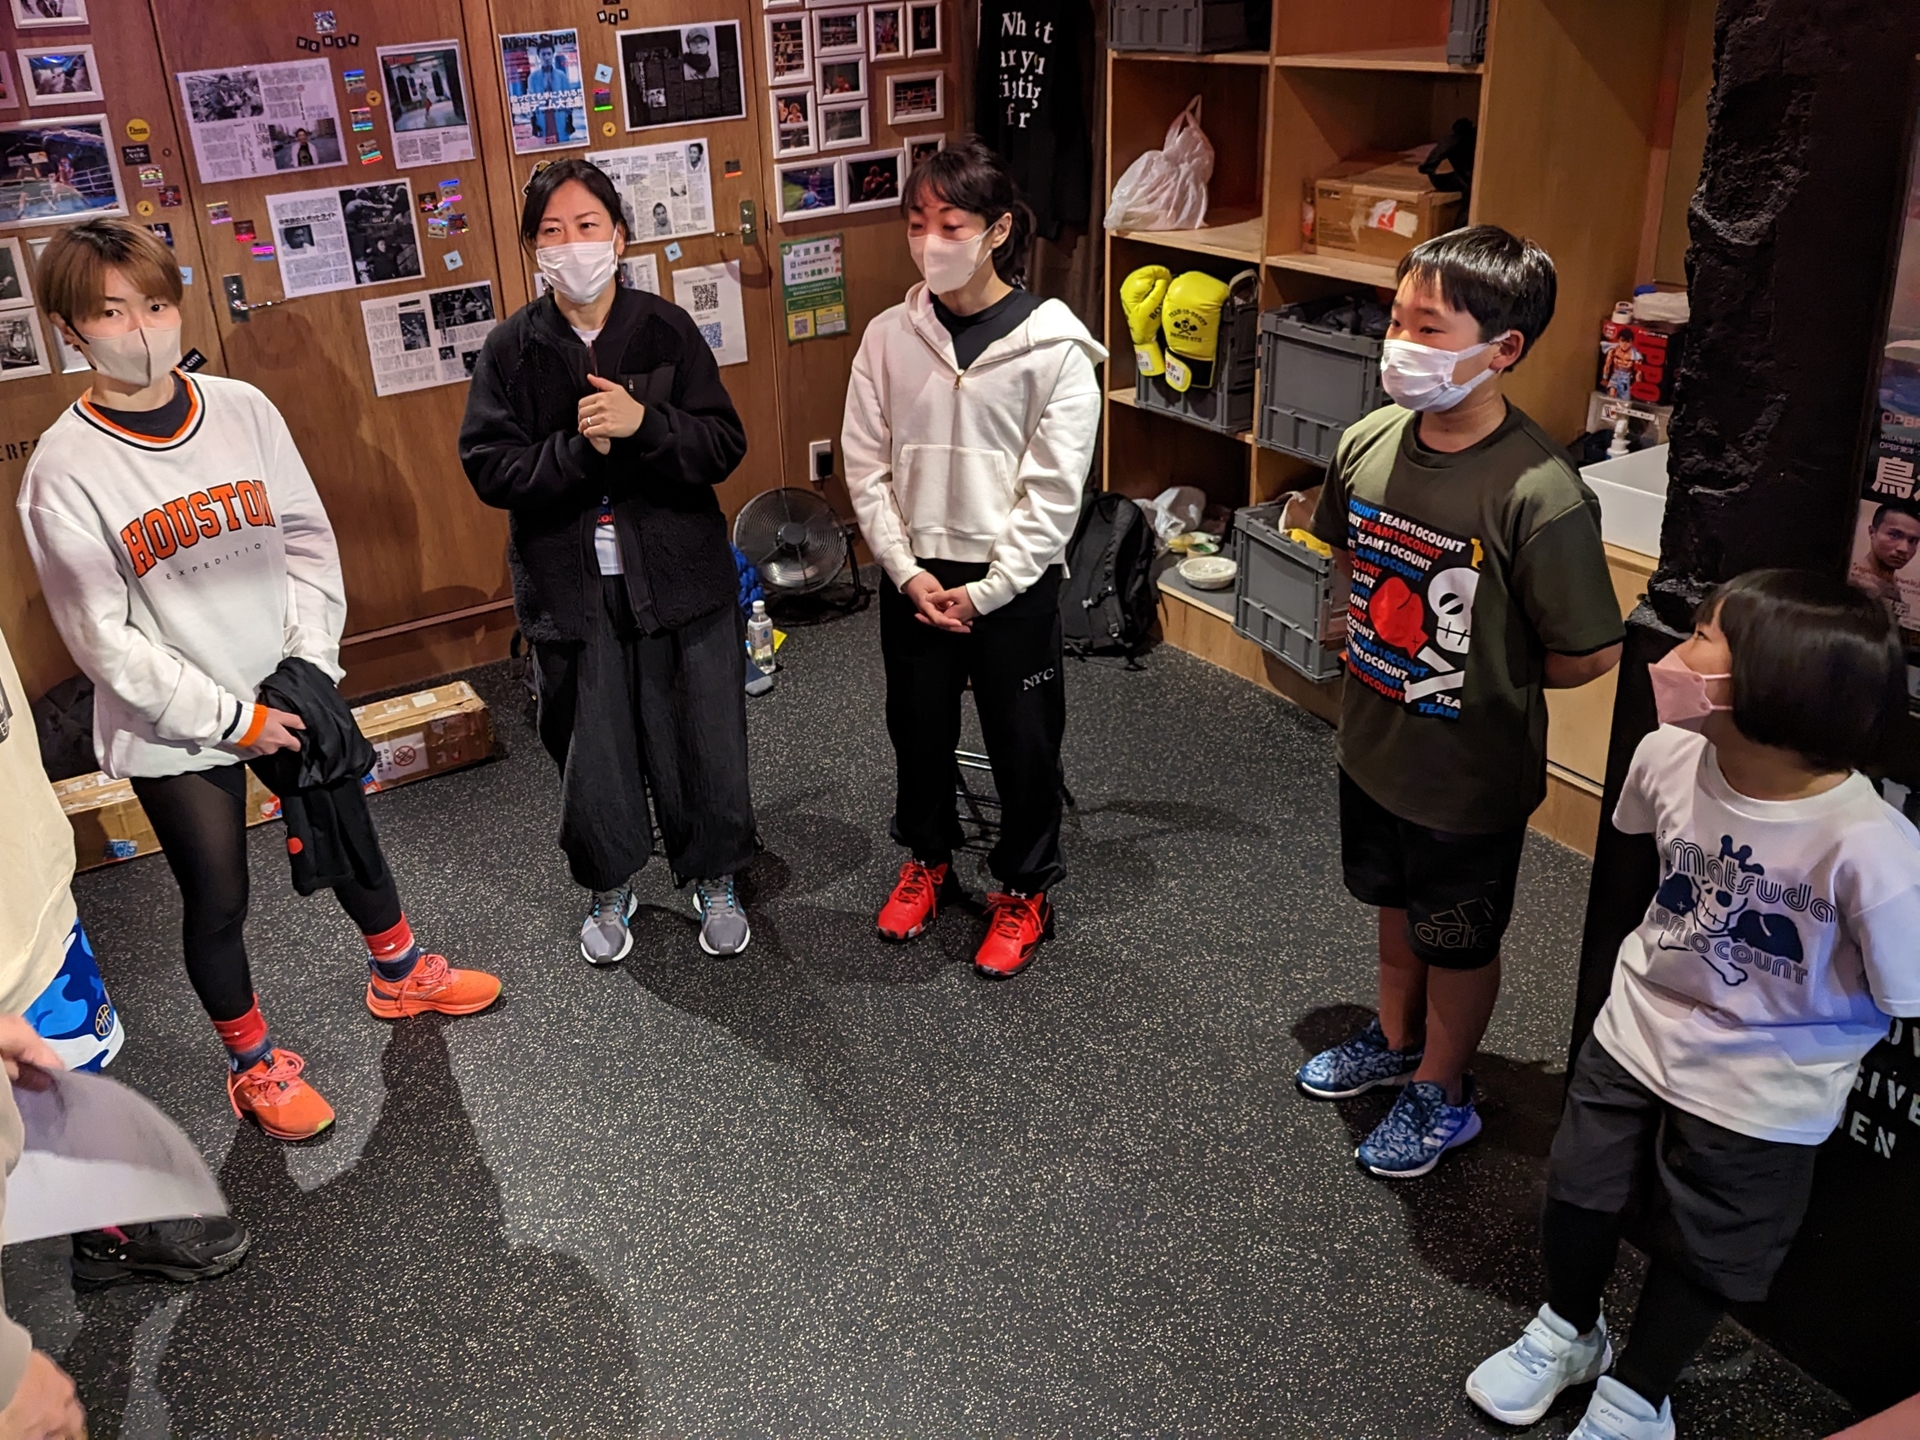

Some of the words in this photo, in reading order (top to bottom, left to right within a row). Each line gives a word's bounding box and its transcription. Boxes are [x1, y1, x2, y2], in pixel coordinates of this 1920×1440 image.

[1630, 335, 1668, 403] IPPO
[1871, 456, 1920, 502] 鳥
[120, 480, 276, 578] HOUSTON
[1361, 519, 1443, 560] TEAM10COUNT
[1379, 511, 1467, 553] TEAM10COUNT
[165, 538, 268, 580] EXPEDITIO
[1022, 667, 1055, 691] NYC
[1838, 1110, 1897, 1159] EN
